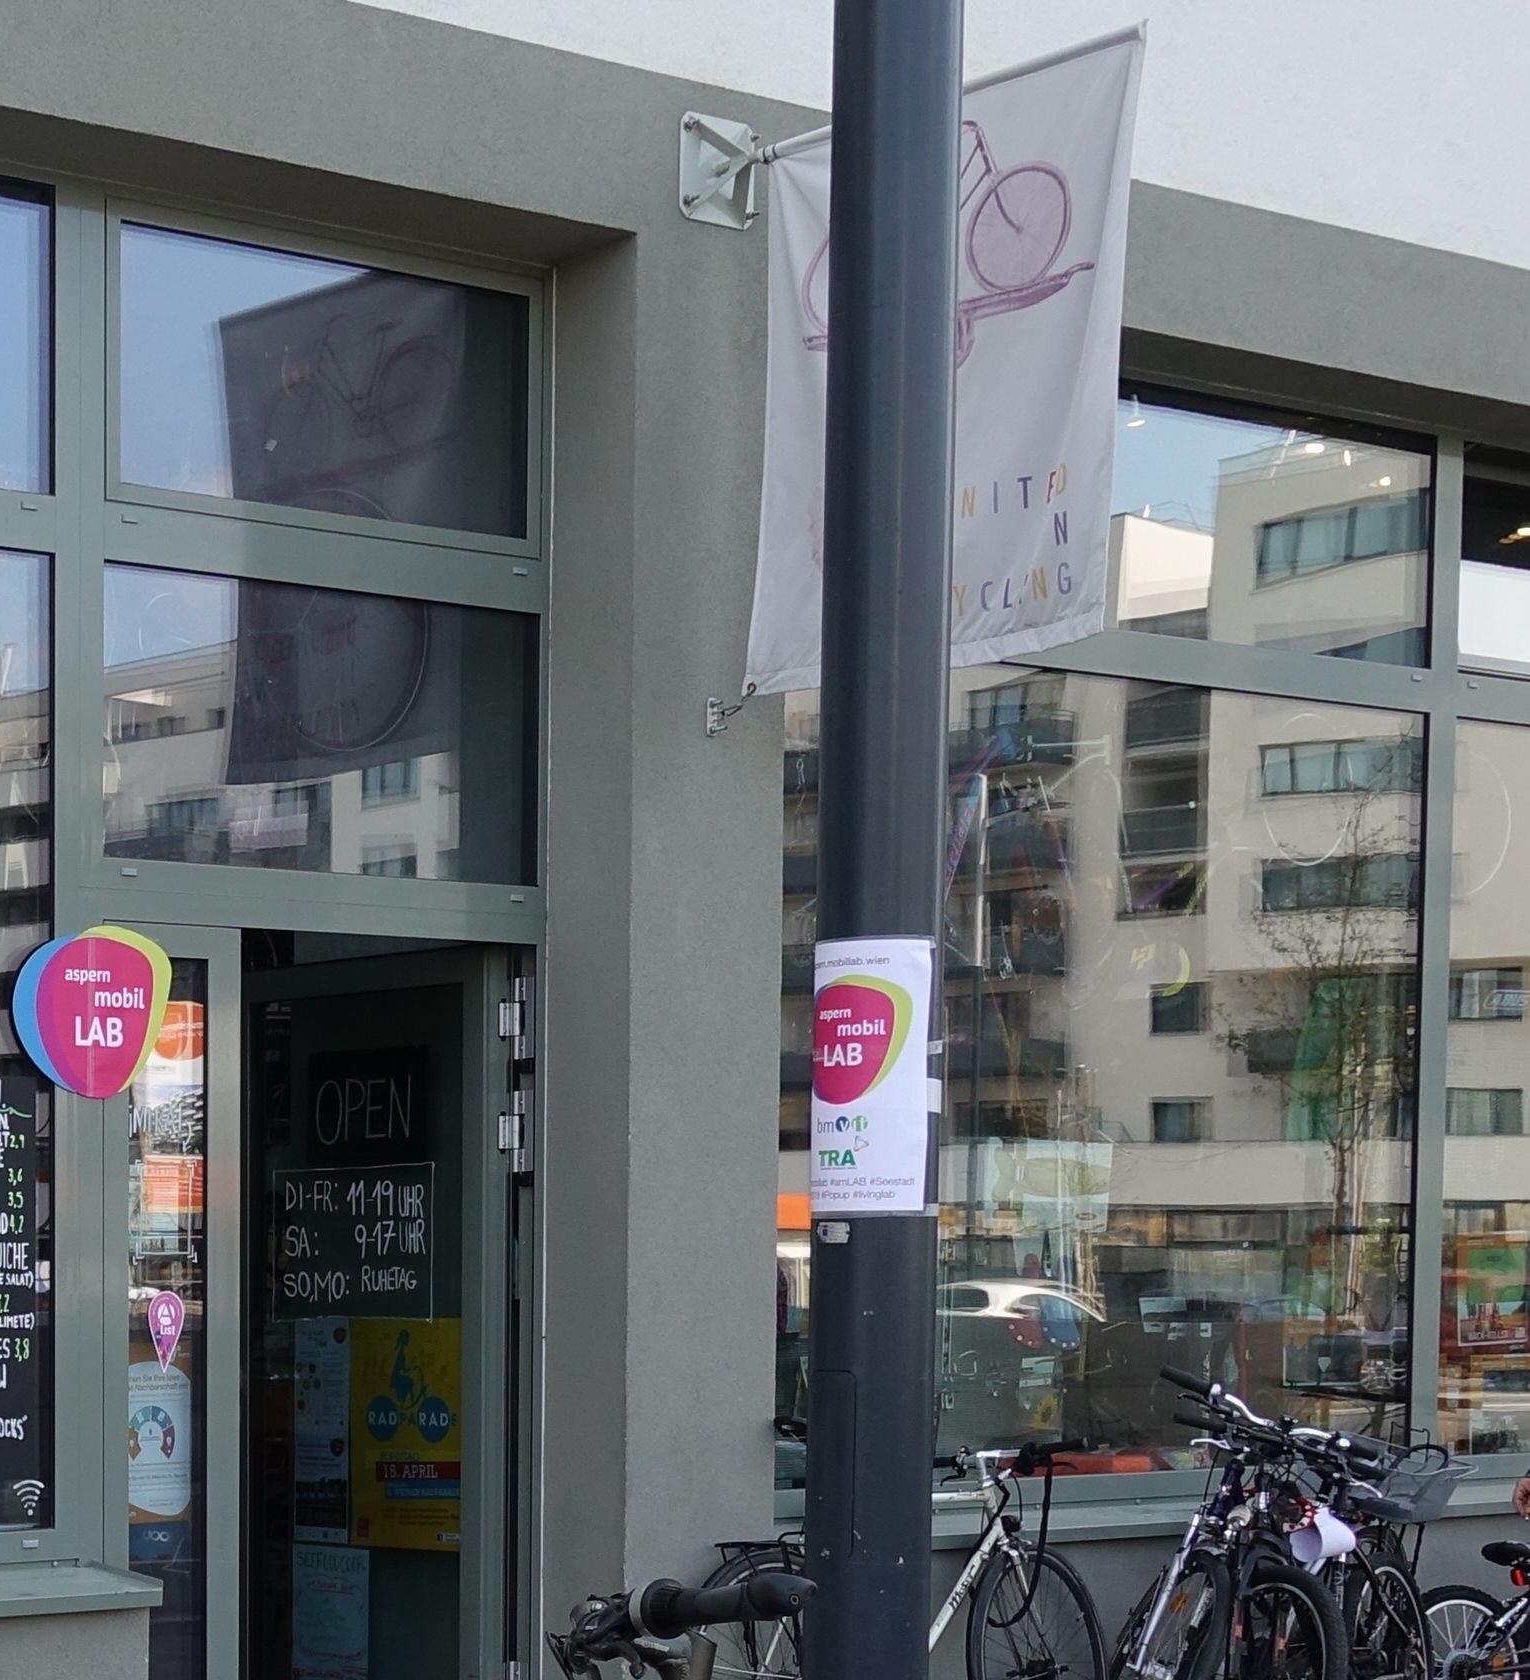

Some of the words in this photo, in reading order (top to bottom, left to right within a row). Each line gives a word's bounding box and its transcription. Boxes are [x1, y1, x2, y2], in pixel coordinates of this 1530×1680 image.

[961, 464, 1067, 518] NITED
[953, 562, 1071, 616] YCLING
[65, 969, 110, 985] aspern
[95, 988, 145, 1009] mobil
[75, 1016, 123, 1047] LAB
[837, 1020, 886, 1037] mobil
[823, 1043, 862, 1067] LAB
[316, 1074, 412, 1145] OPEN
[818, 1149, 856, 1167] TRA
[285, 1180, 338, 1212] DI-FR:
[347, 1180, 393, 1216] 11-19
[398, 1184, 424, 1218] UHR
[355, 1220, 396, 1259] 9-17
[398, 1219, 426, 1255] UHR
[361, 1265, 417, 1292] RUHETAG
[402, 1463, 438, 1480] APRIL
